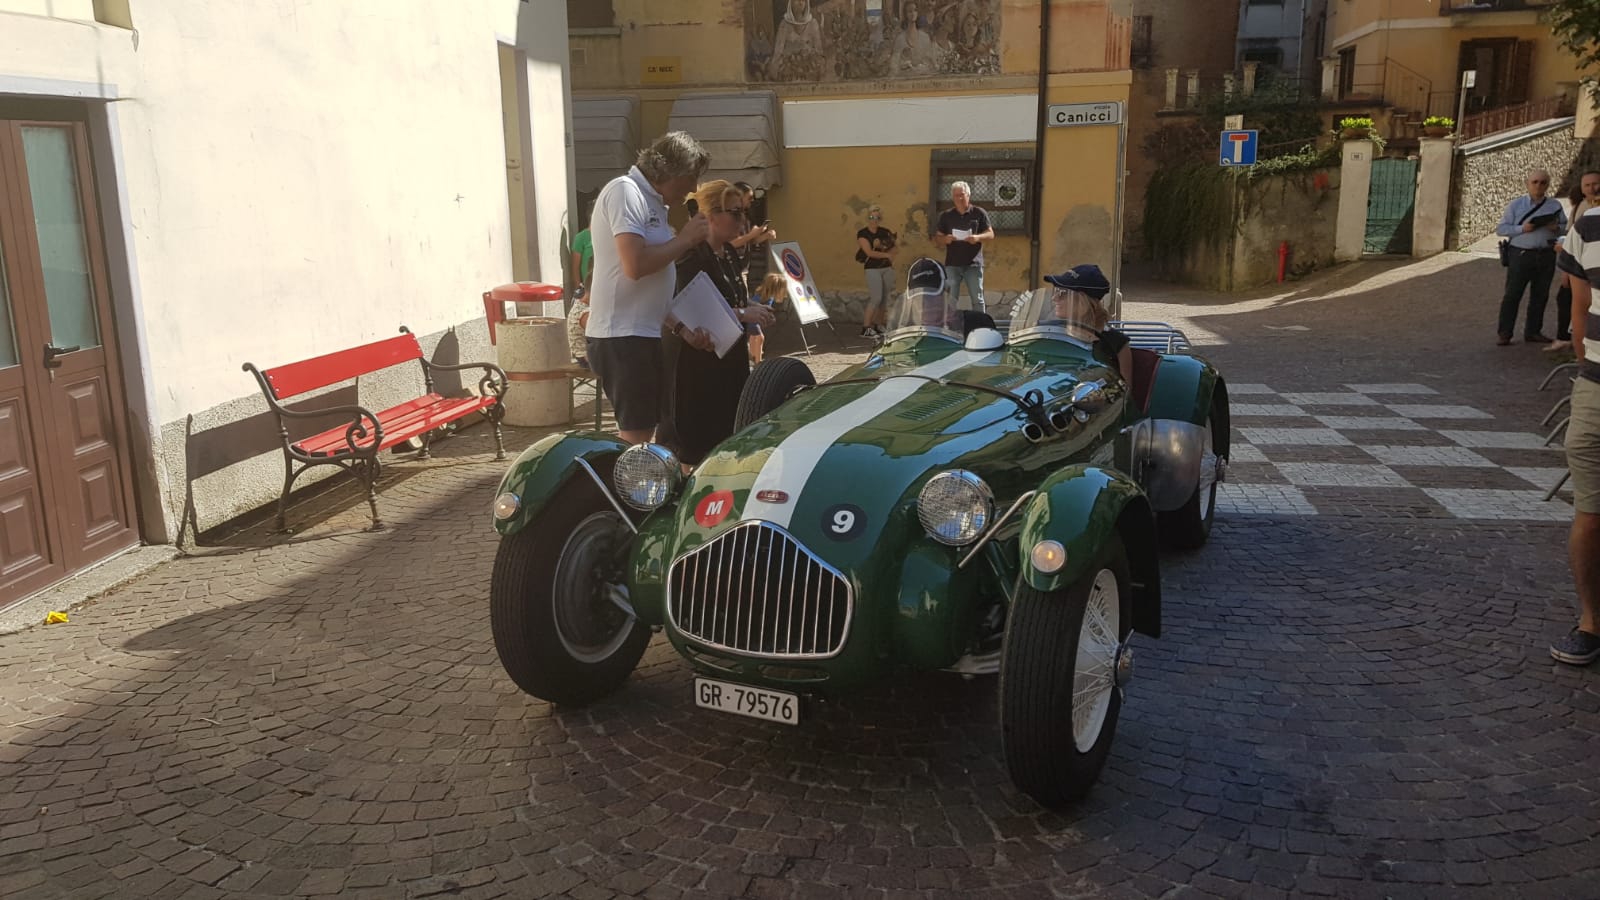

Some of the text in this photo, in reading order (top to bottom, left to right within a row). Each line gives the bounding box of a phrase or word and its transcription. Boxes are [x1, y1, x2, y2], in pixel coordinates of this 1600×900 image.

[1056, 110, 1111, 123] Canicci
[705, 500, 724, 516] M
[831, 510, 855, 534] 9
